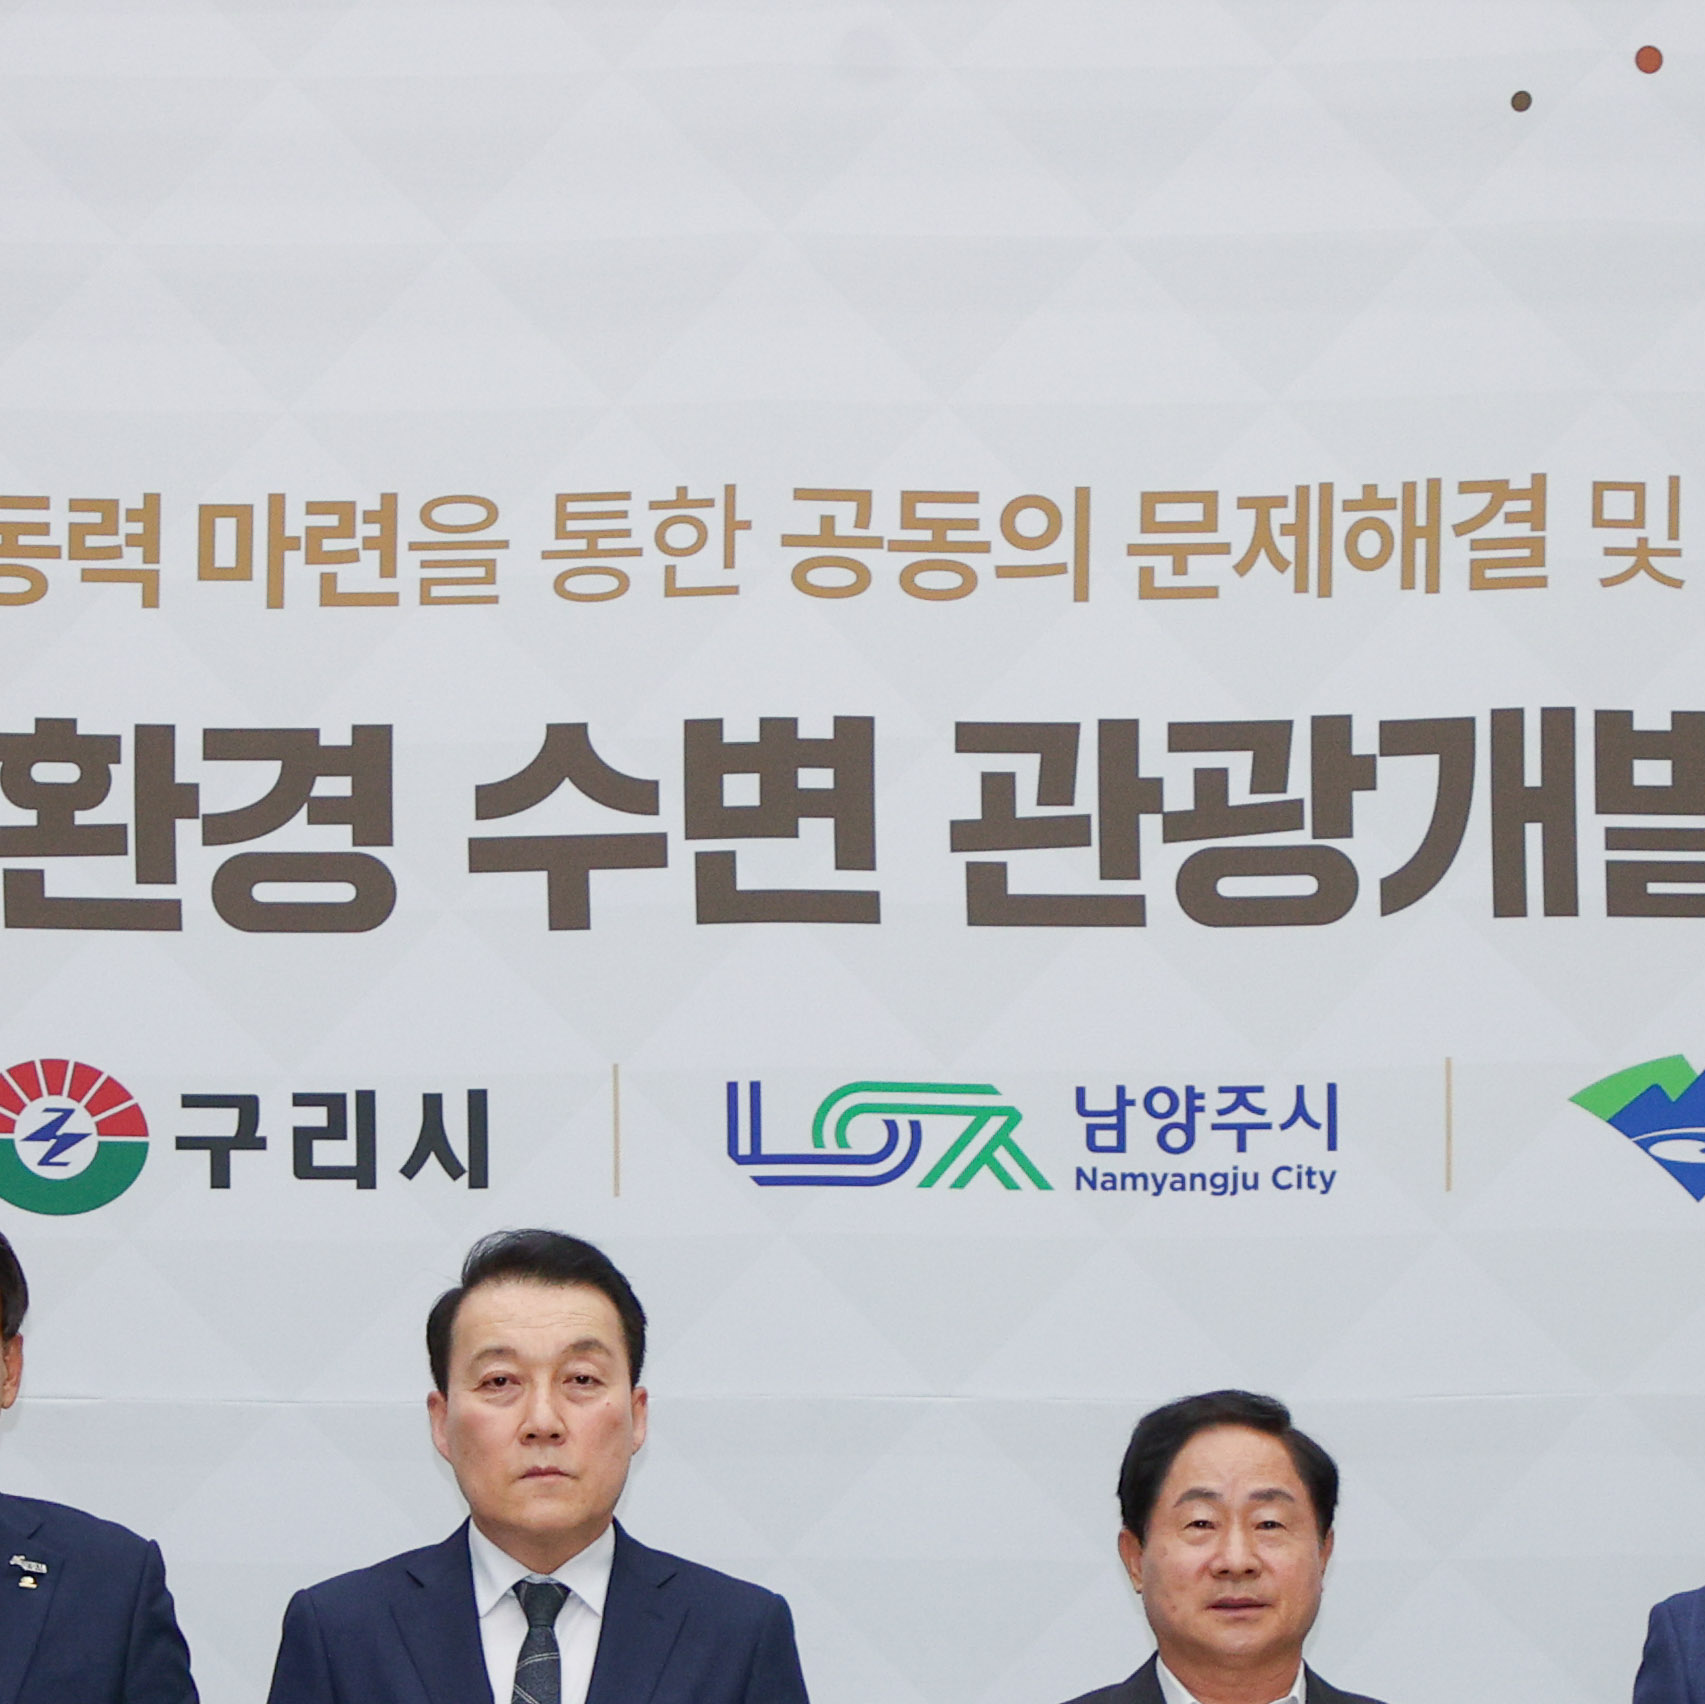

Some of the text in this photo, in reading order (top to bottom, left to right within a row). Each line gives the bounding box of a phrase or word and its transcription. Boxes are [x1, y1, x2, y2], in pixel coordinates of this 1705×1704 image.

[198, 493, 509, 609] 마련을
[541, 484, 752, 602] 통한
[781, 487, 1090, 602] 공동의
[1127, 473, 1548, 600] 문제해결
[1592, 476, 1684, 589] 및
[468, 716, 881, 931] 수변
[175, 1089, 488, 1189] 구리시
[1076, 1083, 1337, 1155] 남양주시
[1076, 1165, 1336, 1196] Namyangju City
